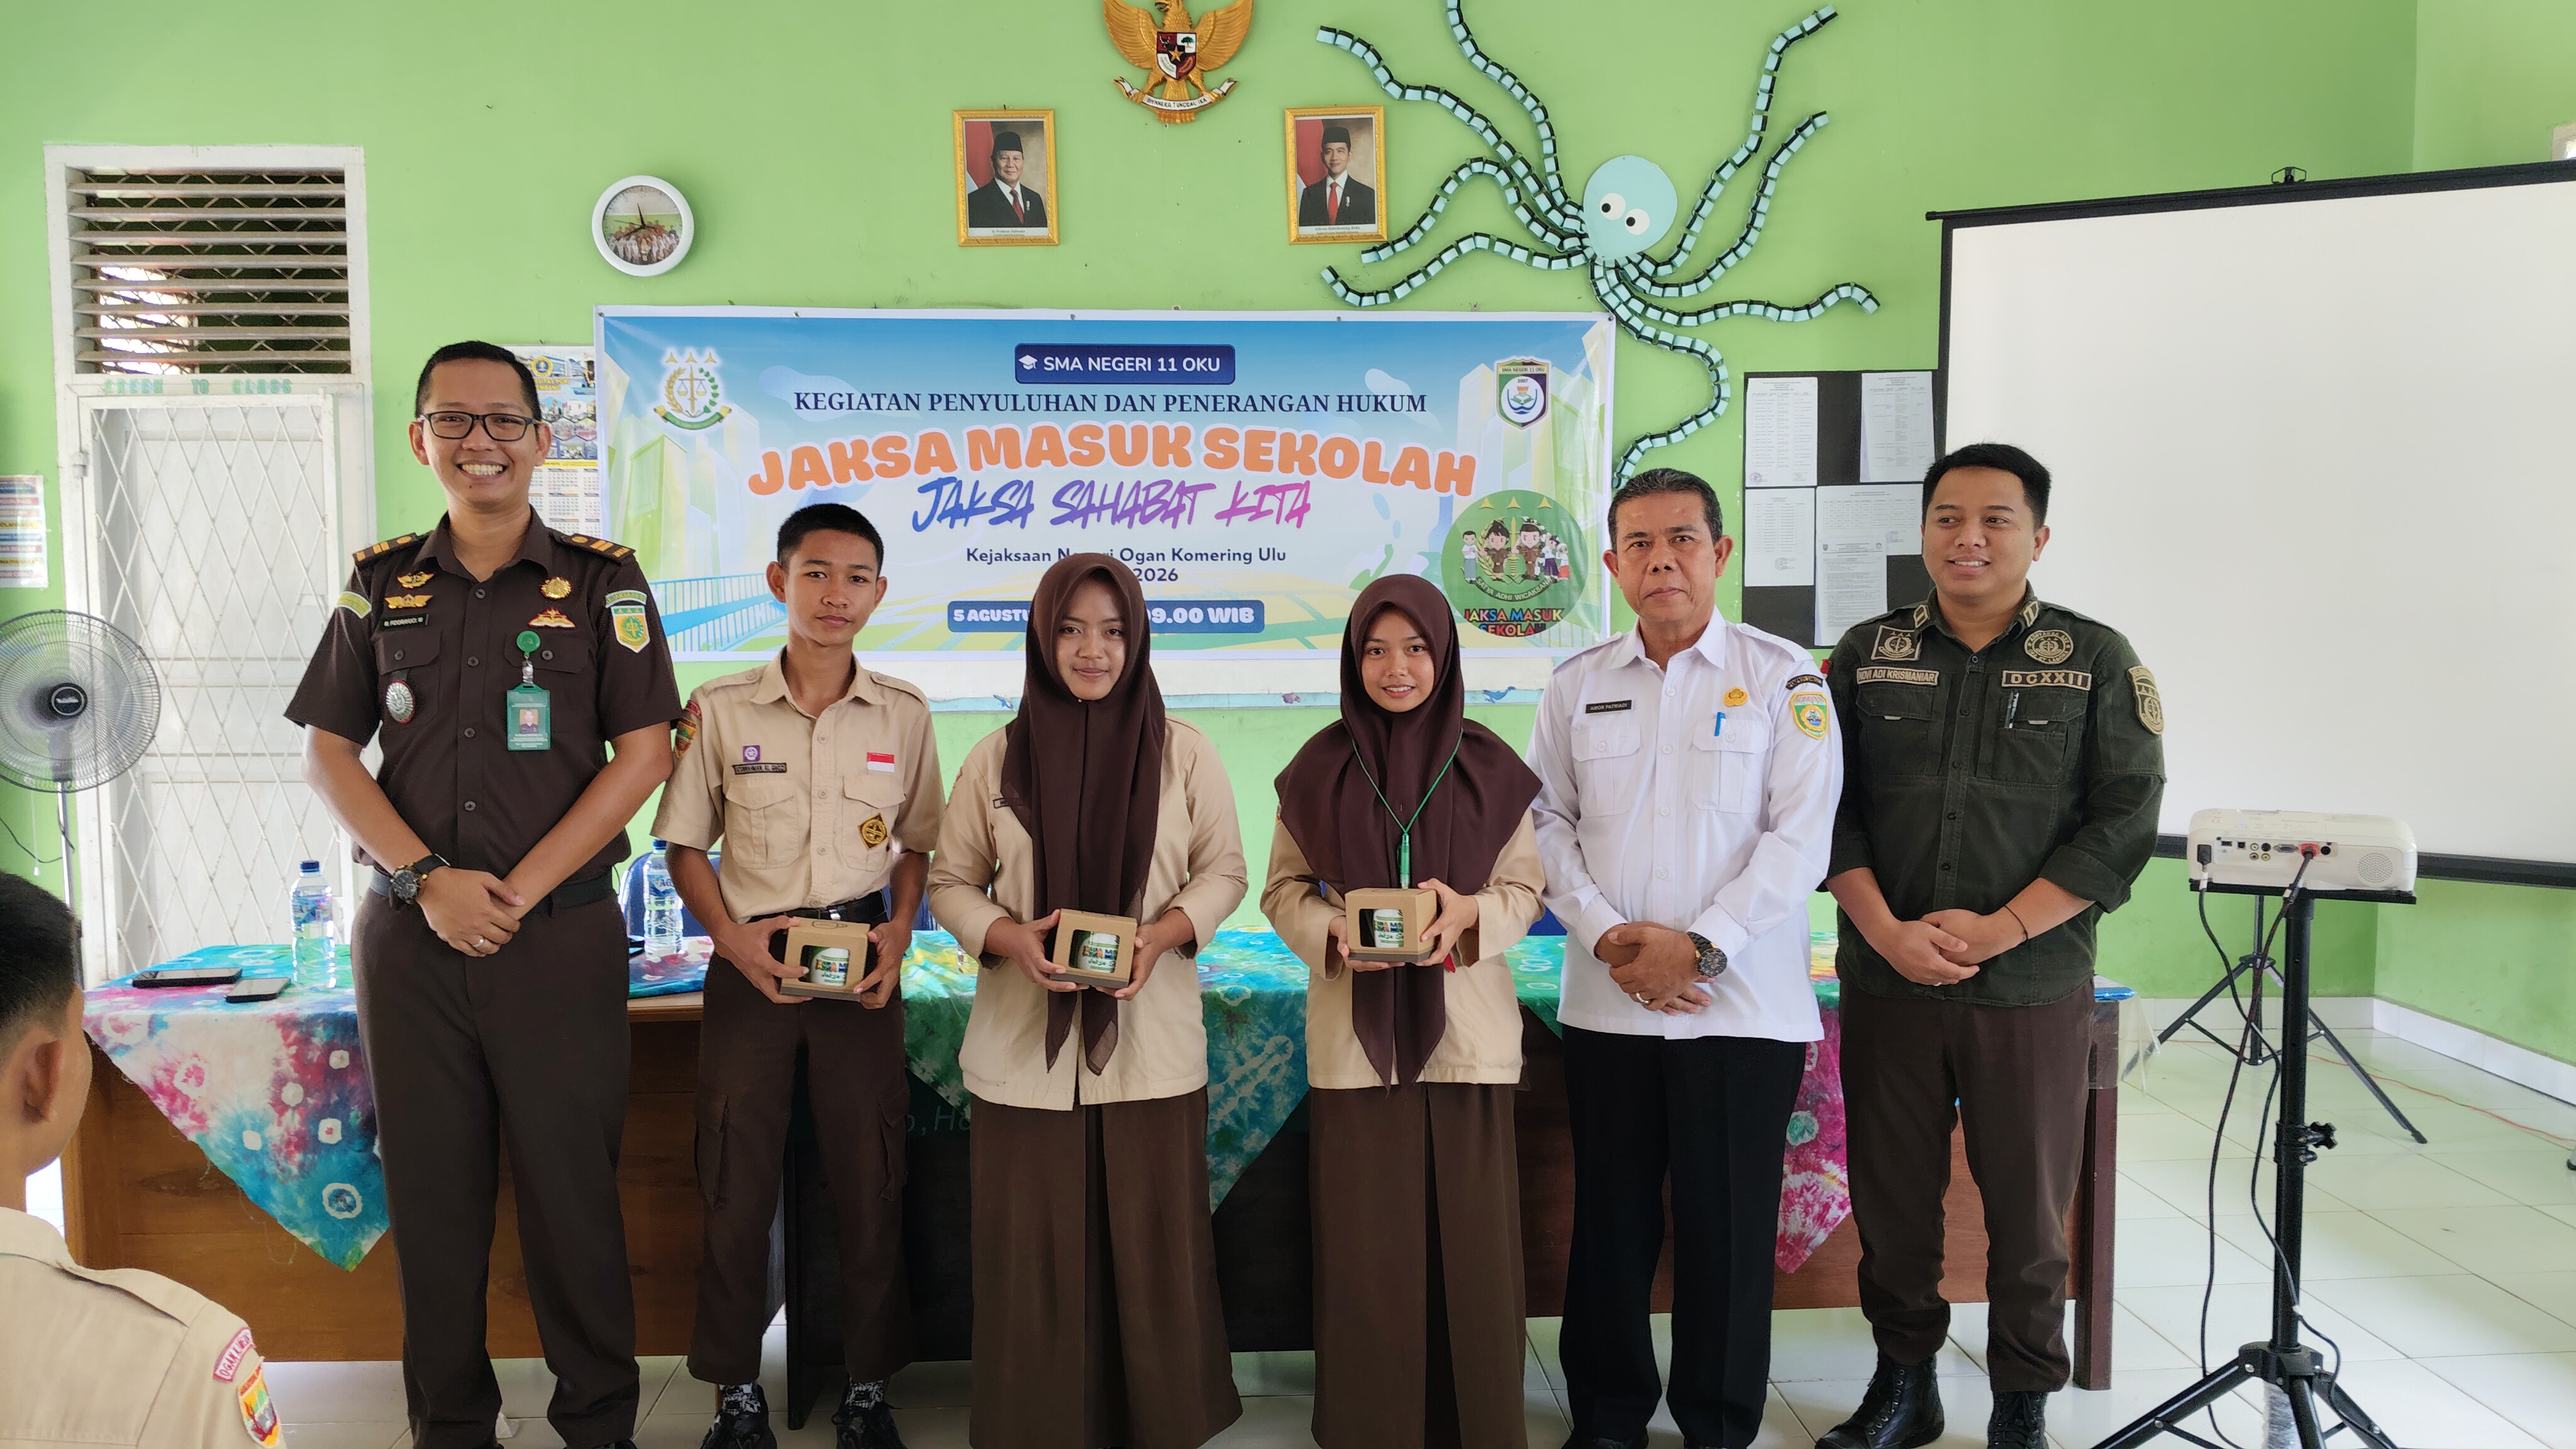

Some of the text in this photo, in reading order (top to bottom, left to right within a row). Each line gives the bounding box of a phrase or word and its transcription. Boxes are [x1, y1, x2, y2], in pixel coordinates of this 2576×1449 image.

[1044, 357, 1220, 372] SMA NEGERI 11 OKU
[794, 392, 1427, 412] KEGIATAN PENYULUHAN DAN PENERANGAN HUKUM
[748, 424, 1476, 497] JAKSA MASUK SEKOLAH
[912, 476, 1311, 532] JAKSA SAHABAT KITA
[967, 548, 1051, 565] Kejaksaan
[1119, 548, 1165, 564] Ogan
[1172, 547, 1252, 564] Komering
[1258, 547, 1286, 561] Ulu
[1133, 568, 1179, 582] 2026
[1476, 578, 1494, 594] SATYA
[953, 609, 965, 621] 5
[1207, 607, 1255, 623] WIB
[1511, 609, 1563, 621] MASUK
[1858, 669, 1935, 682] NOVI ADI KRISMANIAR
